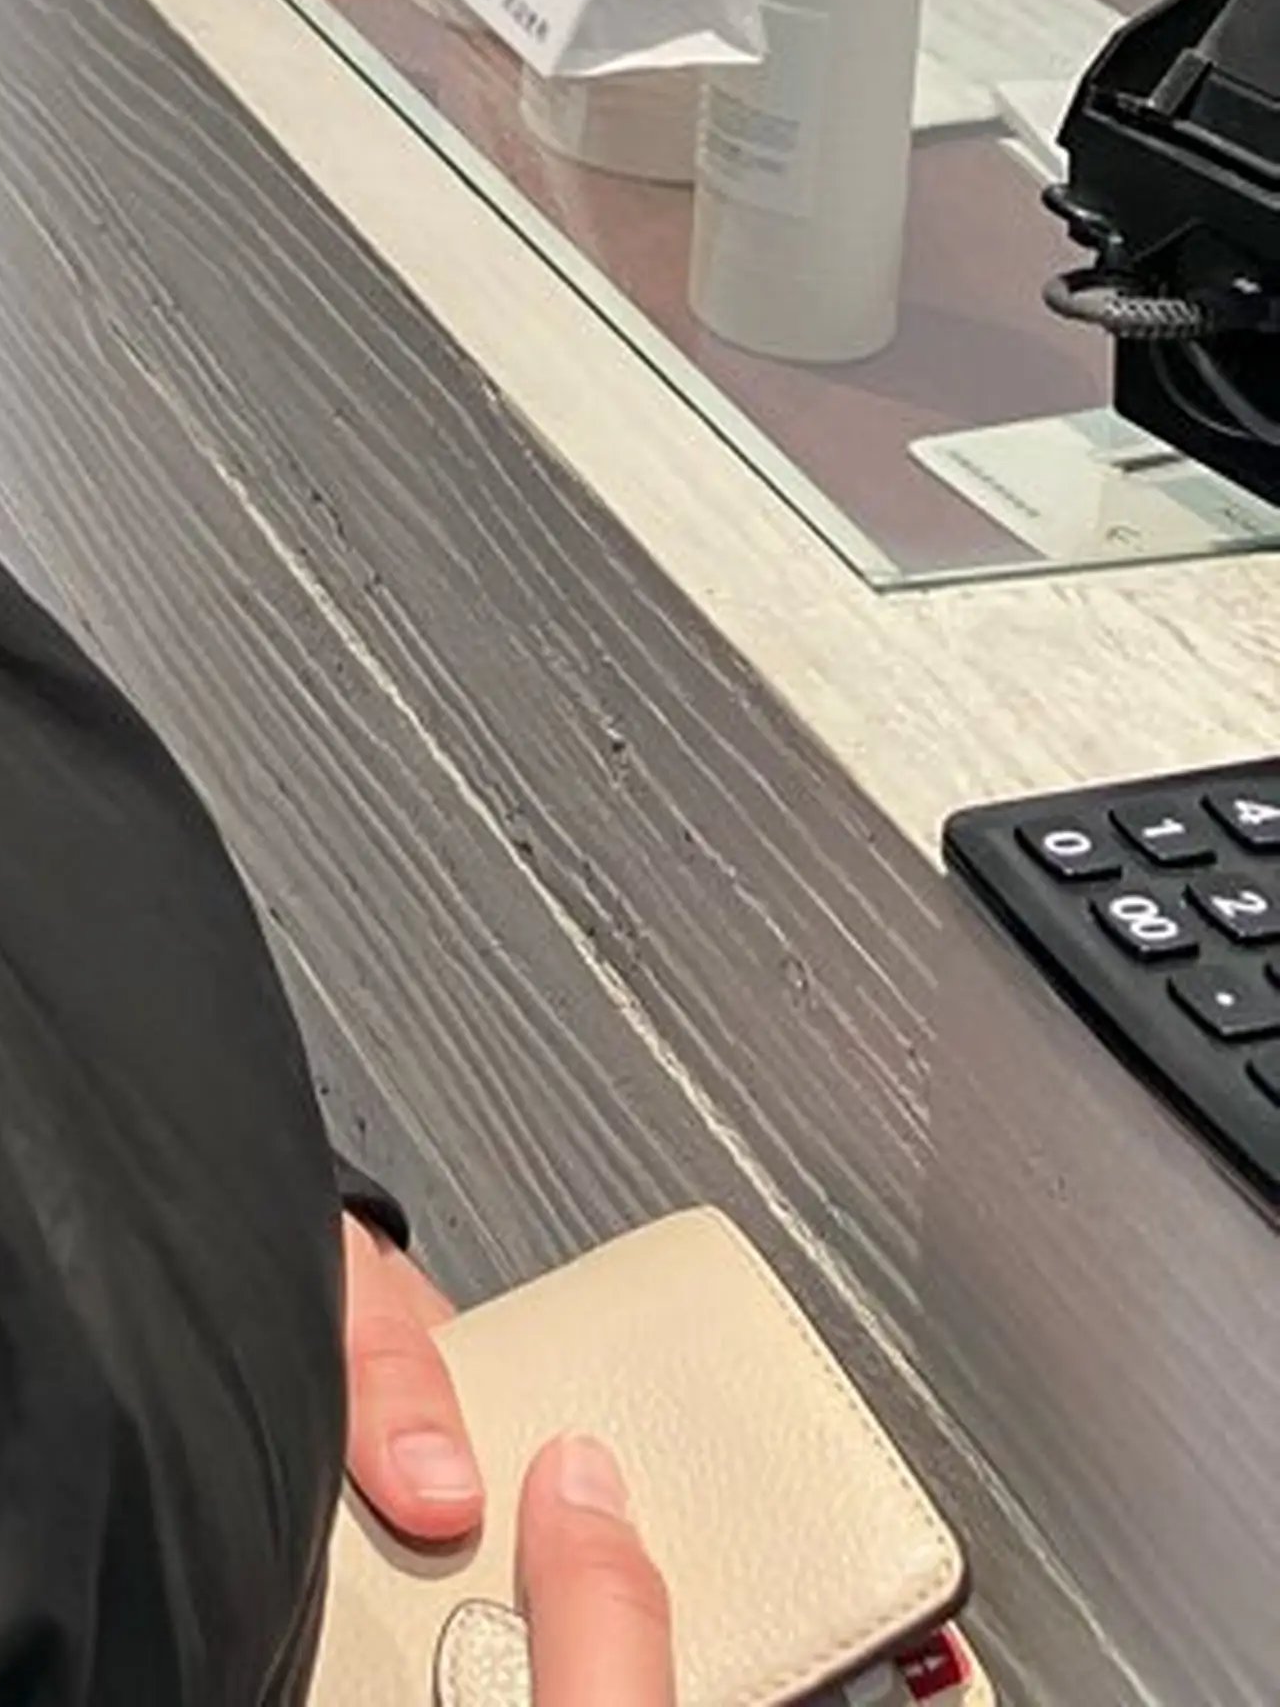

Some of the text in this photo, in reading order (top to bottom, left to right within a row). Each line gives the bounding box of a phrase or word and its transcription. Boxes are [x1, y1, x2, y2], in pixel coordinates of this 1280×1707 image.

[1234, 799, 1280, 825] 4
[1142, 818, 1186, 838] 1
[1043, 830, 1092, 856] 0
[1109, 895, 1178, 940] 00
[1211, 890, 1268, 919] 2
